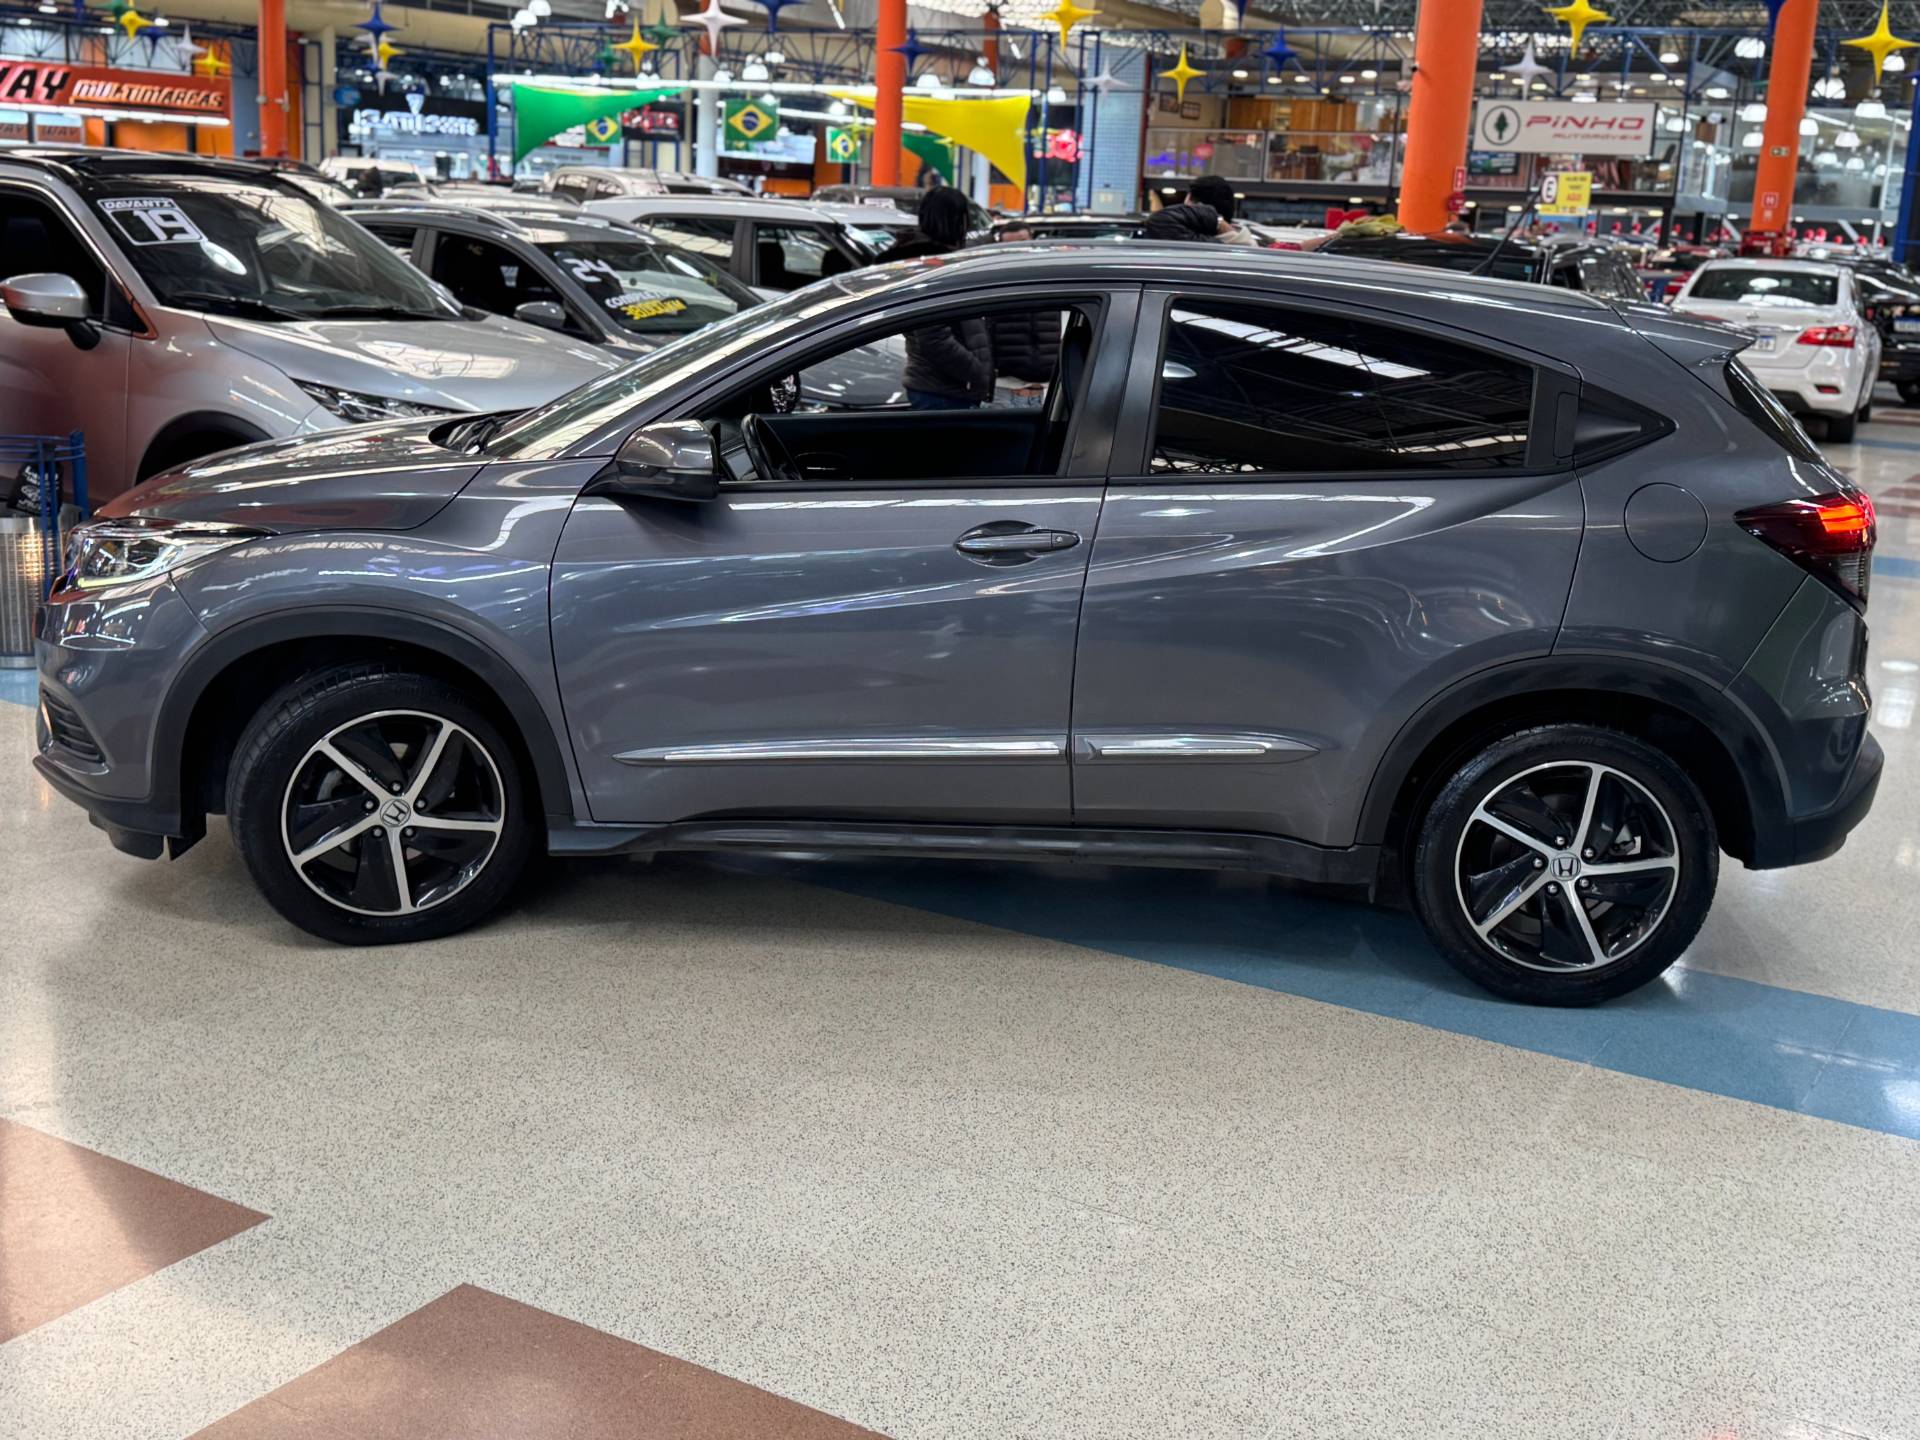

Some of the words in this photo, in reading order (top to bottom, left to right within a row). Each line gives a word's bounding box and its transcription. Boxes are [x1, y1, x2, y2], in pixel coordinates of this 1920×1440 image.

[1526, 115, 1645, 131] PINHO
[133, 209, 201, 241] 19
[563, 257, 621, 283] 24
